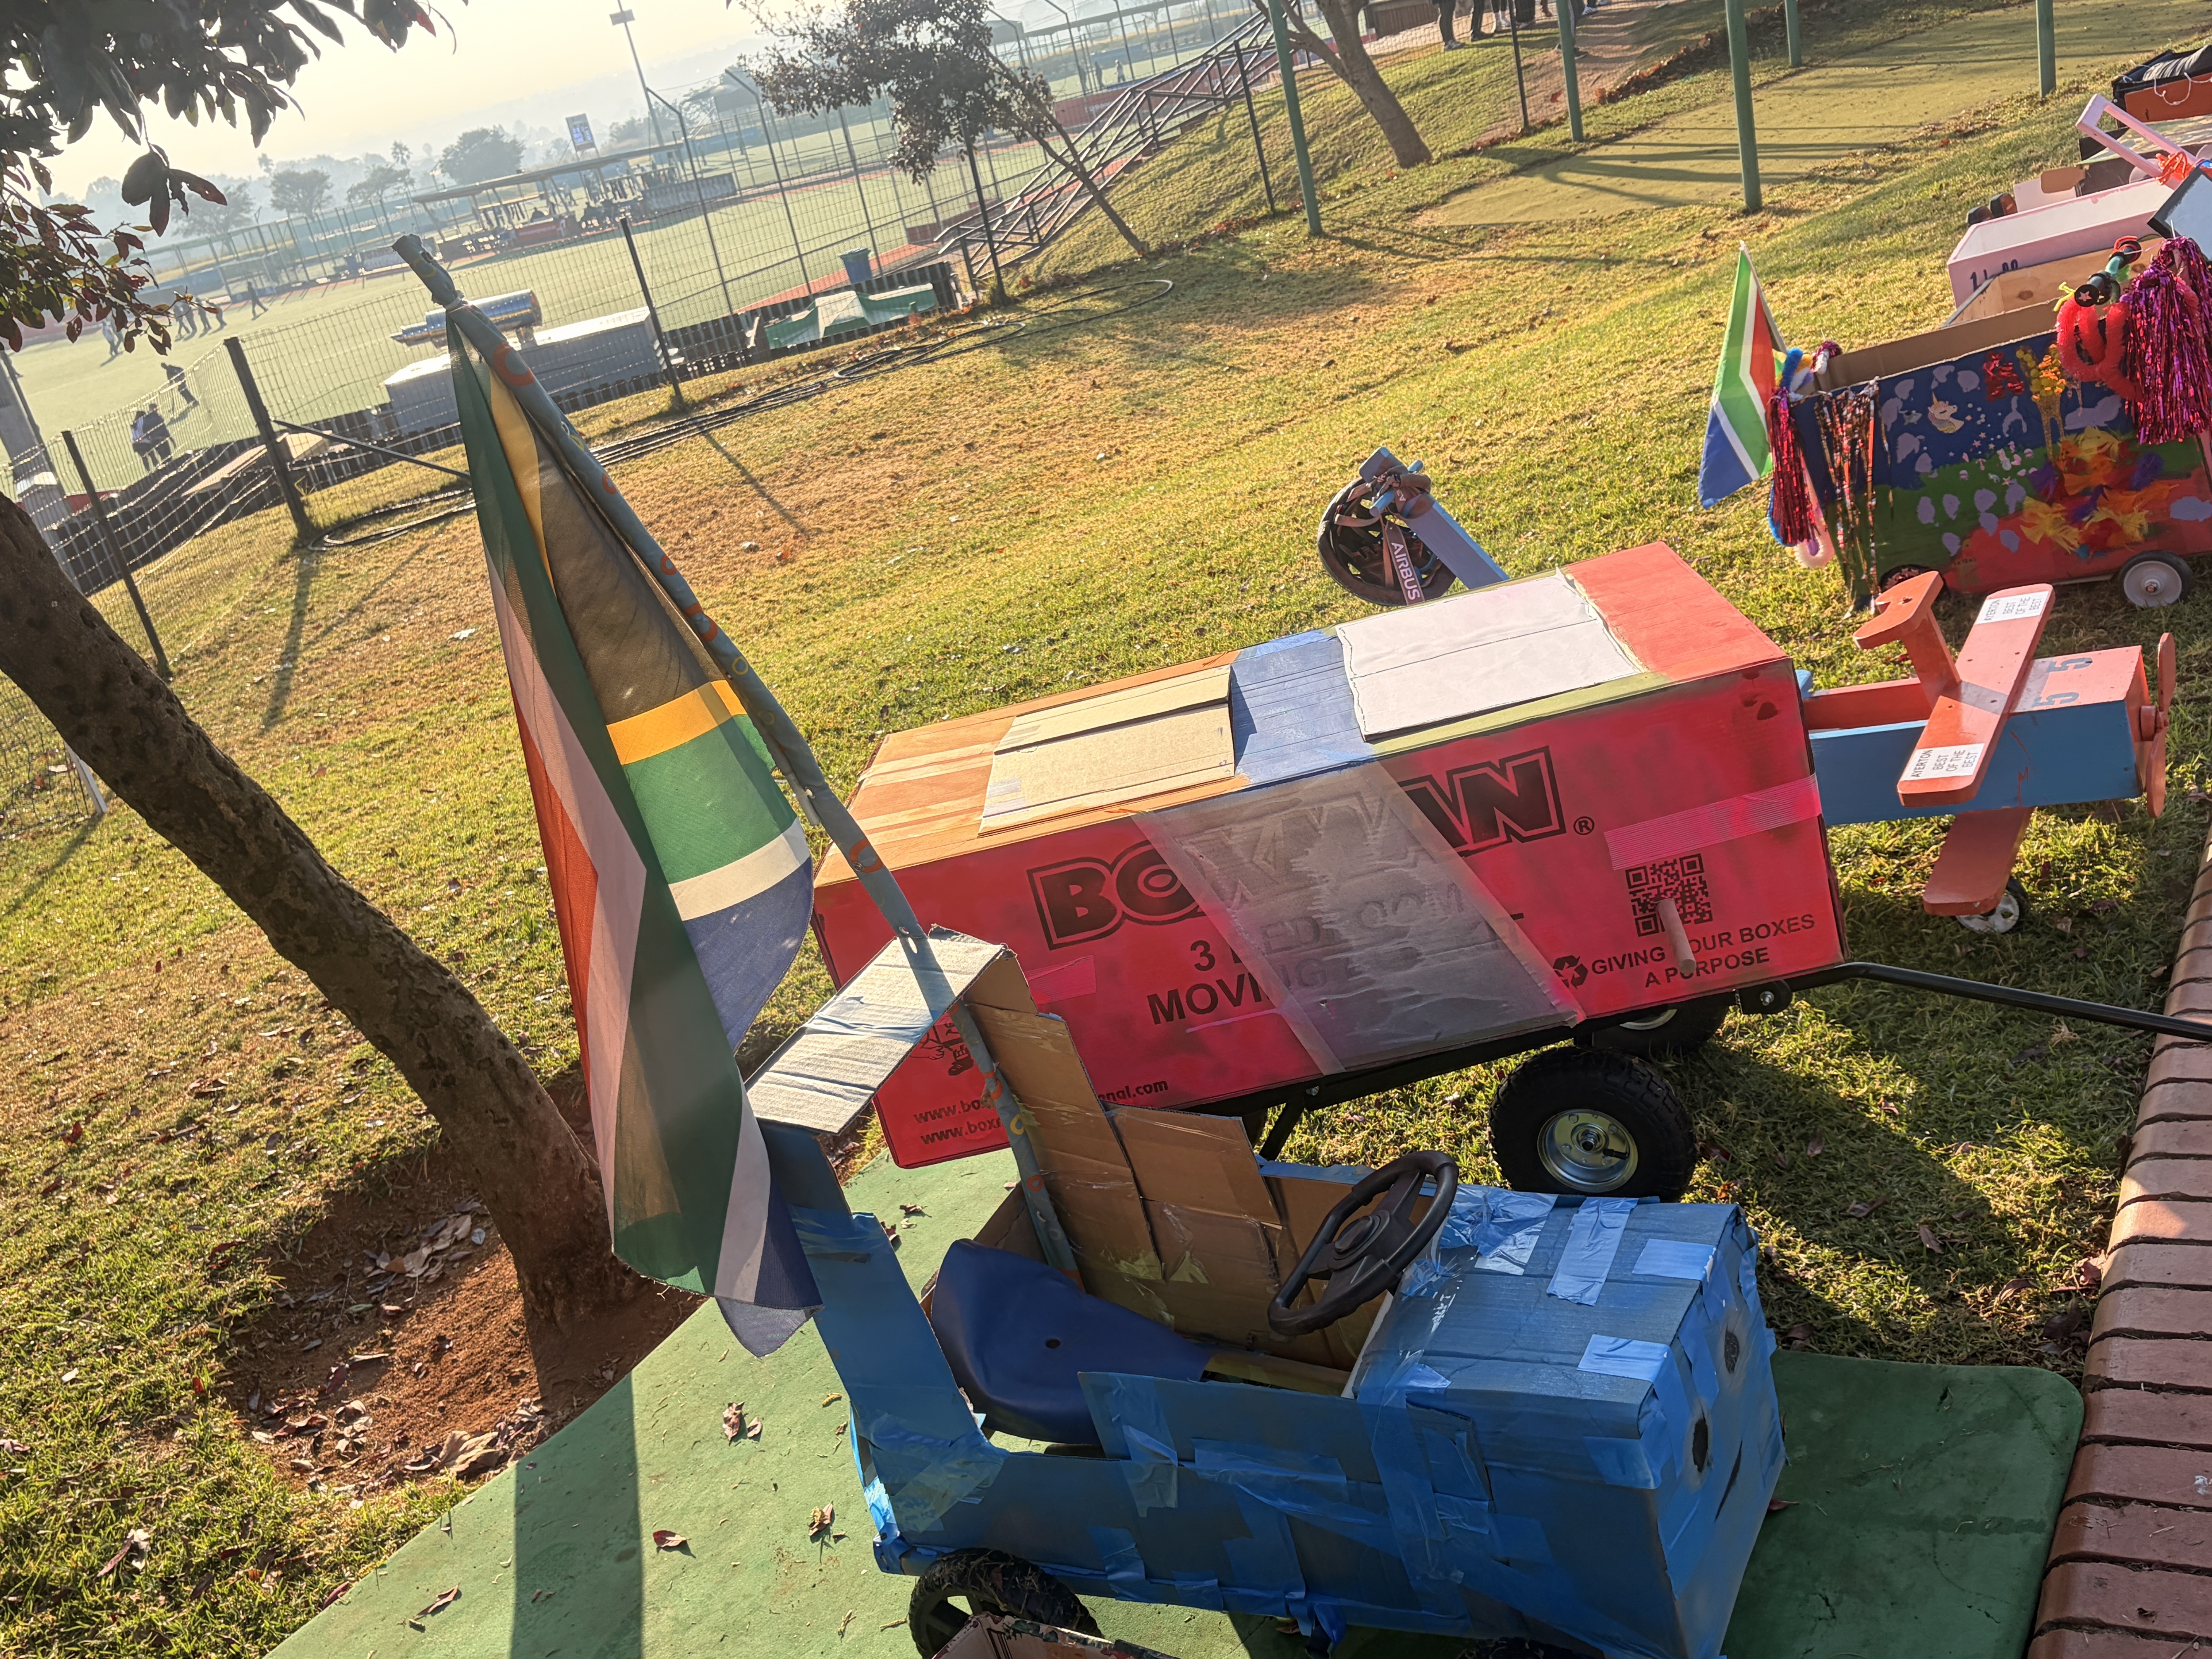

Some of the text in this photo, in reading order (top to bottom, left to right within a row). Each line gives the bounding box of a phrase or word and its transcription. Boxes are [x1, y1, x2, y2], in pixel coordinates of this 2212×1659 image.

[1391, 542, 1420, 600] AIRBUS
[2002, 602, 2016, 615] BEST
[2018, 597, 2031, 607] THE
[2029, 598, 2042, 610] BEST
[1910, 749, 1934, 777] AYERTON
[1932, 754, 1949, 770] BEST
[1946, 749, 1966, 772] OF THE
[1962, 752, 1978, 768] BEST
[1592, 914, 1815, 974] GIVING OUR BOXES
[1190, 939, 1216, 971] 3
[1645, 972, 1661, 988] A
